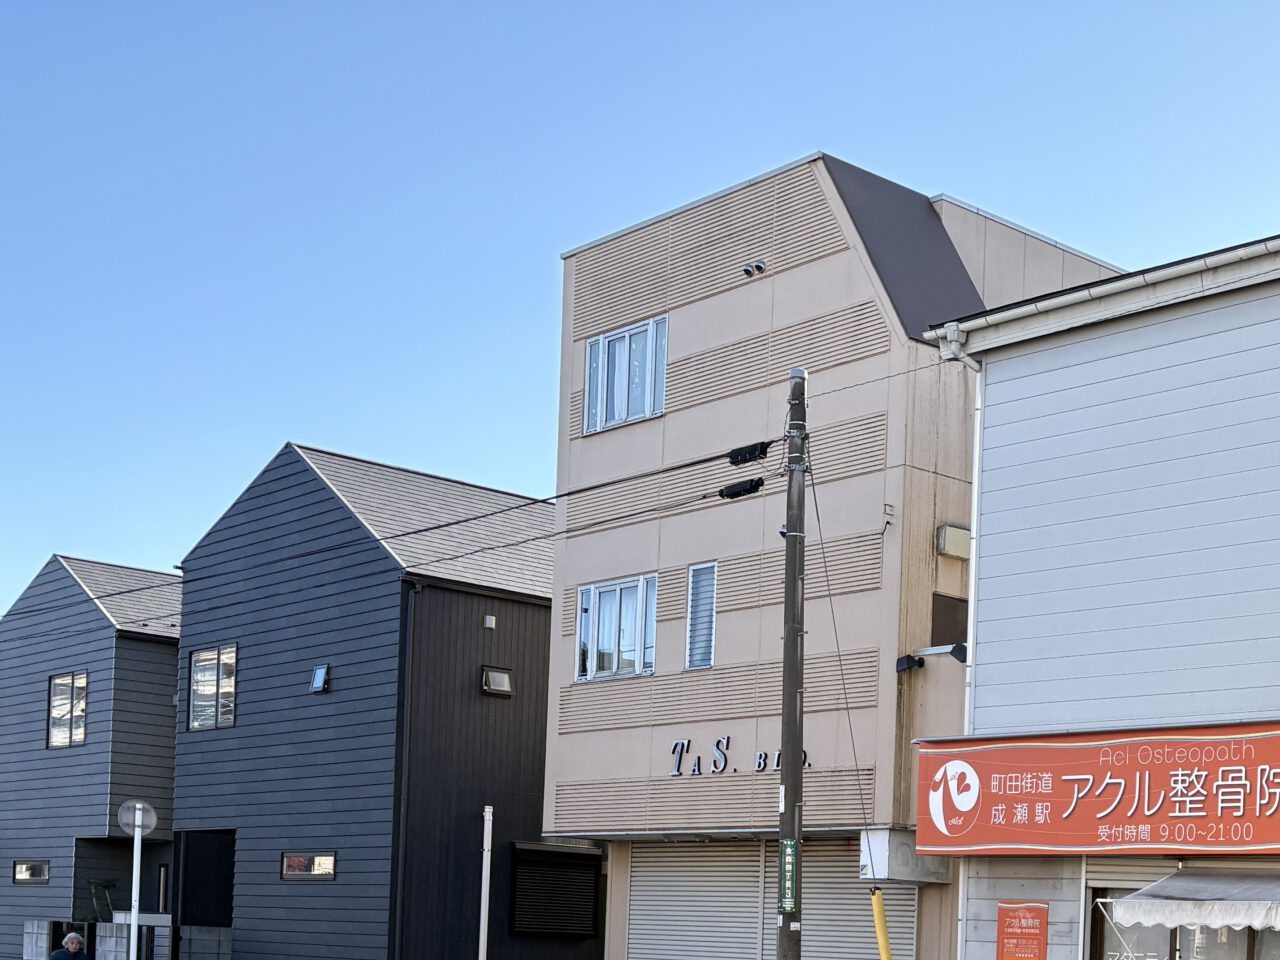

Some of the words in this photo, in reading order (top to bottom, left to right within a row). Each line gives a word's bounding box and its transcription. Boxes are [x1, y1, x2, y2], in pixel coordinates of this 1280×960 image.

[1099, 746, 1129, 766] Acl
[1137, 740, 1256, 766] Osteopath
[991, 772, 1053, 795] 町田街道
[990, 802, 1052, 825] 成瀬駅
[1097, 824, 1151, 842] 受付時間
